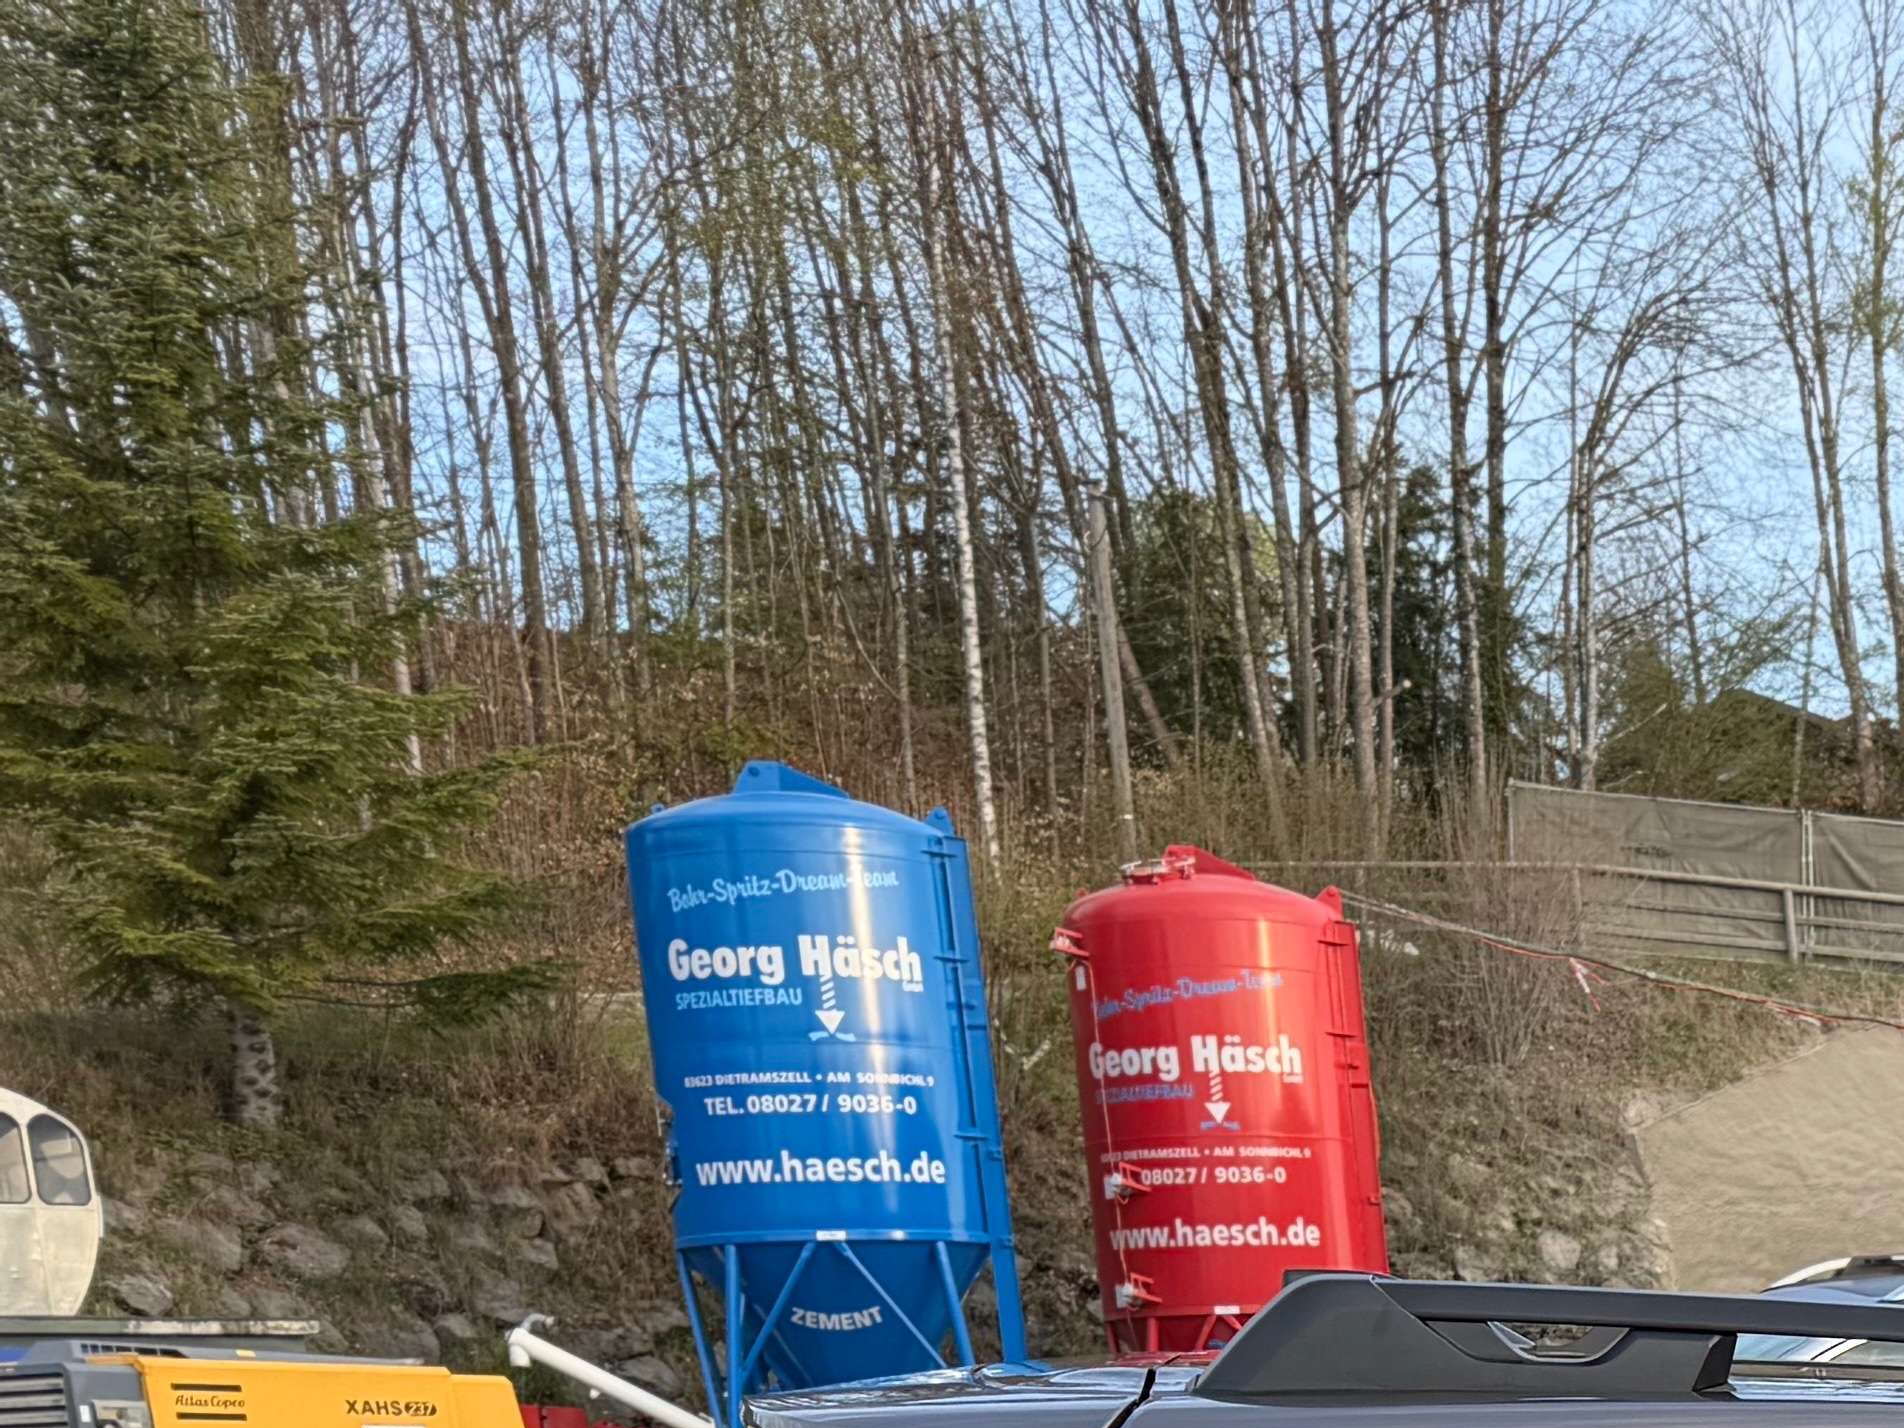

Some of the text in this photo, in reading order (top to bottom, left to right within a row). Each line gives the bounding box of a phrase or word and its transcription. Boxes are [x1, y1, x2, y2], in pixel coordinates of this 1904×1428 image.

[668, 934, 924, 986] Georg Häsch
[675, 987, 803, 1010] SPEZIALTIEFBAU
[1089, 1033, 1303, 1083] Georg Häsch
[715, 1072, 812, 1086] DIETRAMSZELL
[827, 1072, 851, 1083] AM
[704, 1096, 745, 1116] TEL.
[747, 1094, 817, 1114] 08027
[838, 1094, 917, 1115] 9036-0
[696, 1150, 946, 1187] www.haesch.de
[1141, 1167, 1198, 1185] 08027
[1214, 1166, 1287, 1184] 9036-0
[1109, 1216, 1321, 1250] www.haesch.de
[790, 1305, 883, 1331] ZEMENT
[175, 1394, 246, 1410] Atlas Copco
[346, 1399, 402, 1417] XAHS
